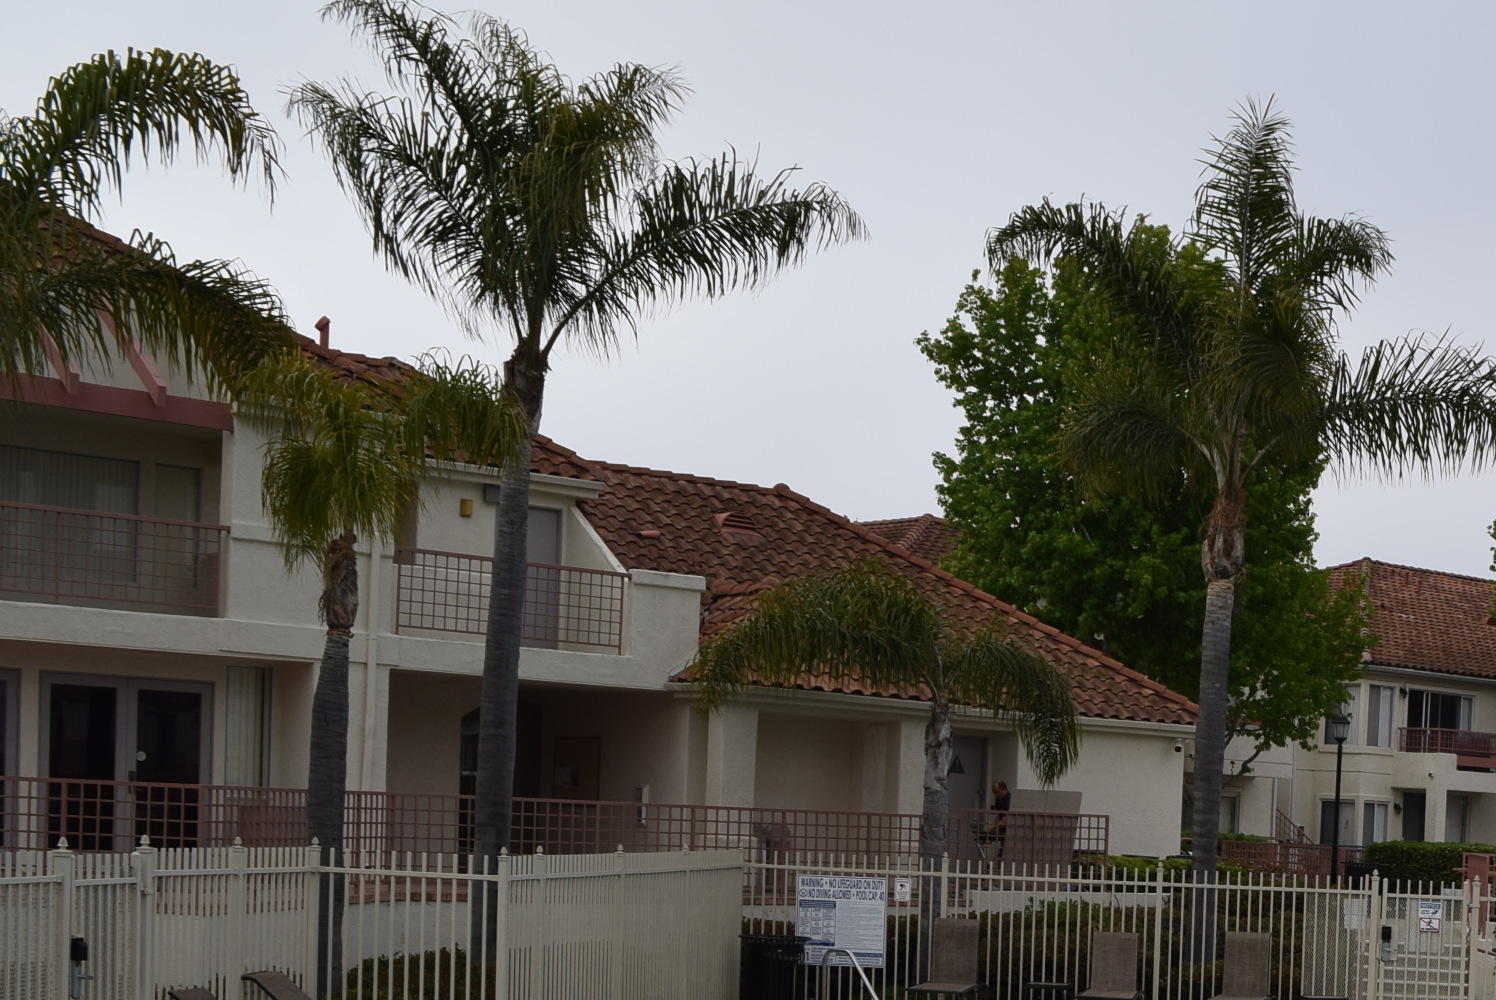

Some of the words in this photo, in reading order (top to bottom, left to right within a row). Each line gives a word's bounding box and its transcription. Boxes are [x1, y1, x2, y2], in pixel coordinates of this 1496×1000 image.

[801, 878, 824, 888] WARNING
[829, 879, 837, 889] NO
[838, 879, 862, 890] LIFEGUARD
[863, 880, 870, 890] ON
[872, 880, 883, 890] DUTY
[808, 889, 815, 899] NO
[816, 889, 832, 899] DIVING
[832, 890, 851, 900] ALLOWED
[856, 890, 868, 901] POOL
